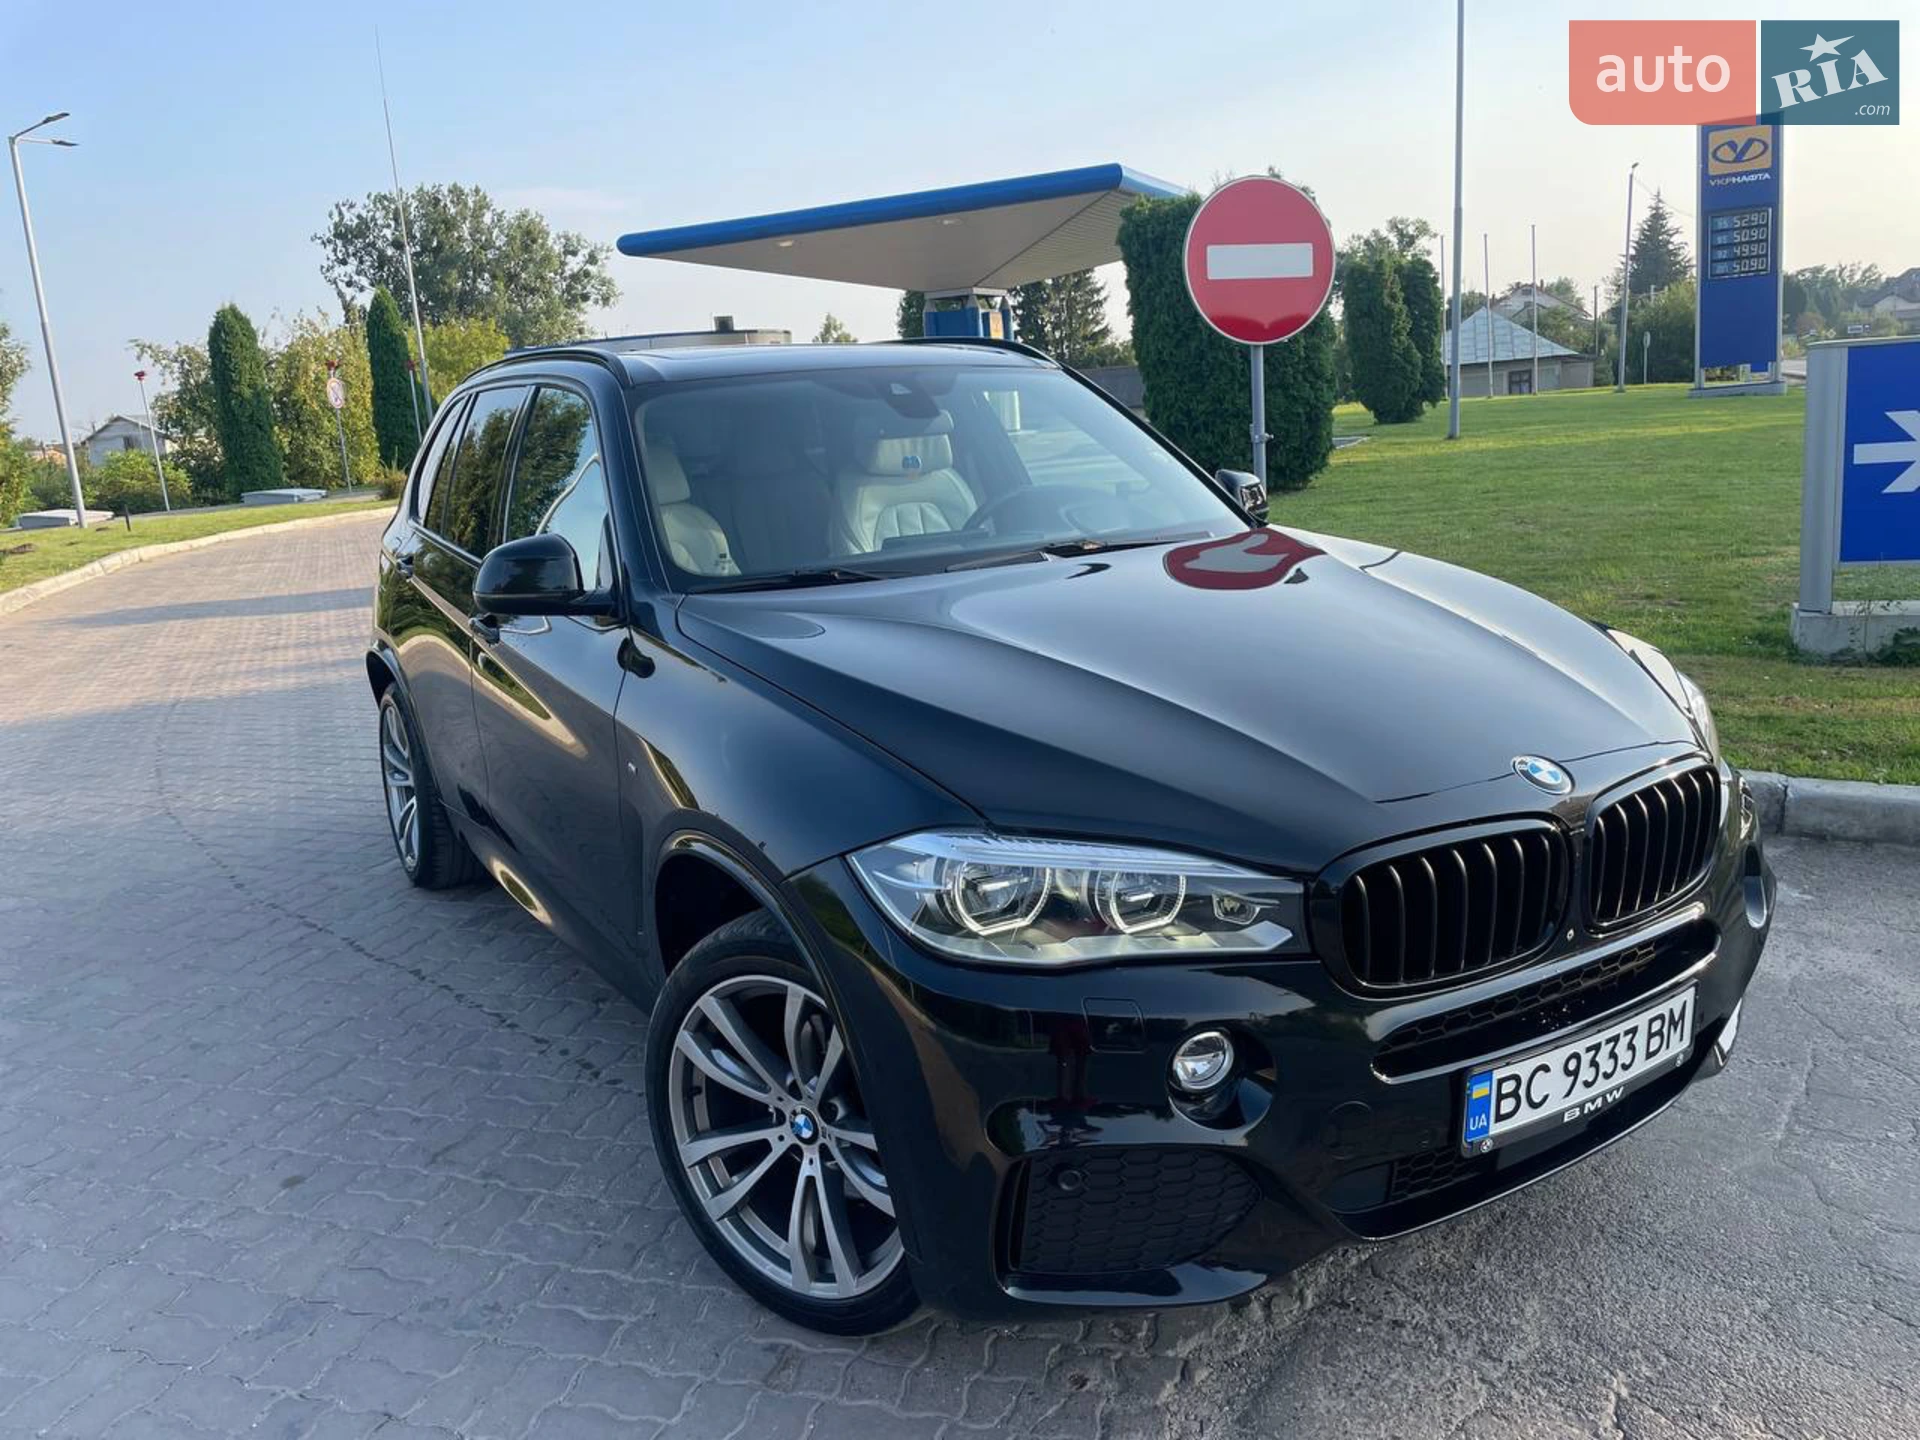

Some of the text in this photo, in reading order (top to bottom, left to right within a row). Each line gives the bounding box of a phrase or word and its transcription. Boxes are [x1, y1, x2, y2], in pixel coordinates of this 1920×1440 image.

[1495, 999, 1687, 1124] BC 9333 BM
[1469, 1113, 1488, 1131] UA
[1563, 1086, 1624, 1123] BMW
